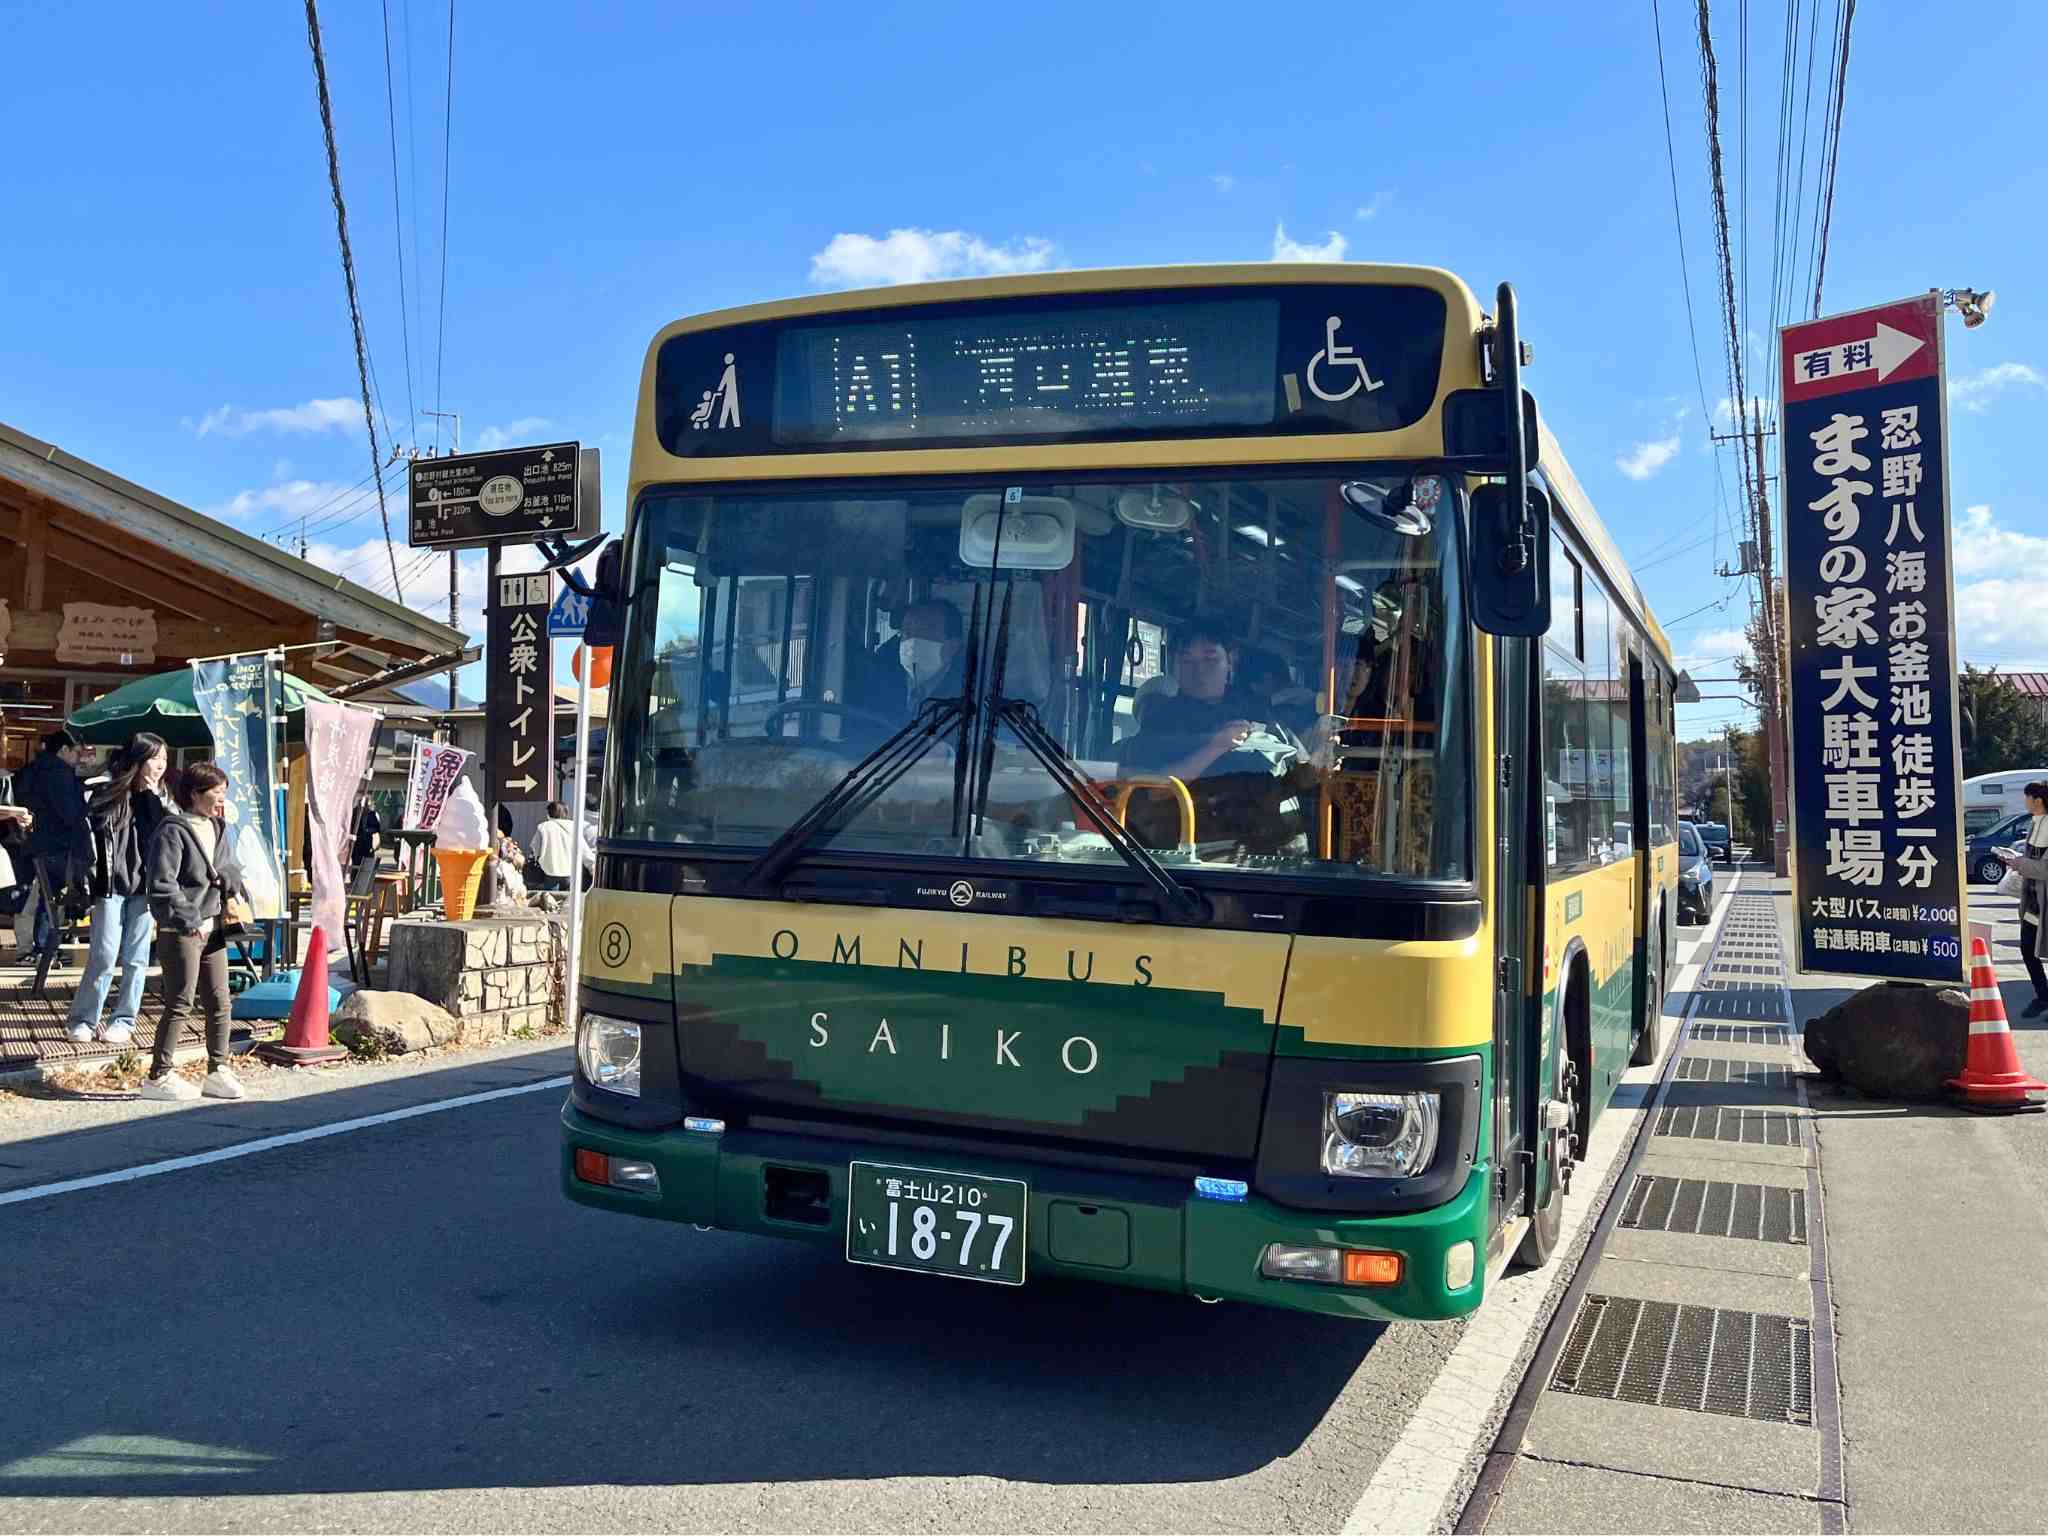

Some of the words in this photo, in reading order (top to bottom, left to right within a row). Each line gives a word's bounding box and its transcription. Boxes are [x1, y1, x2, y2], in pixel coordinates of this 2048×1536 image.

[1803, 341, 1873, 379] 有料
[508, 612, 540, 768] 公衆トイレ
[916, 887, 949, 897] FUJIKYU
[975, 891, 1007, 900] RAILWAY
[771, 929, 1154, 987] OMNIBUS
[809, 1012, 1099, 1074] SAIKO
[885, 1178, 982, 1207] 富士山210
[858, 1217, 877, 1234] い
[888, 1202, 1014, 1270] 18-77
